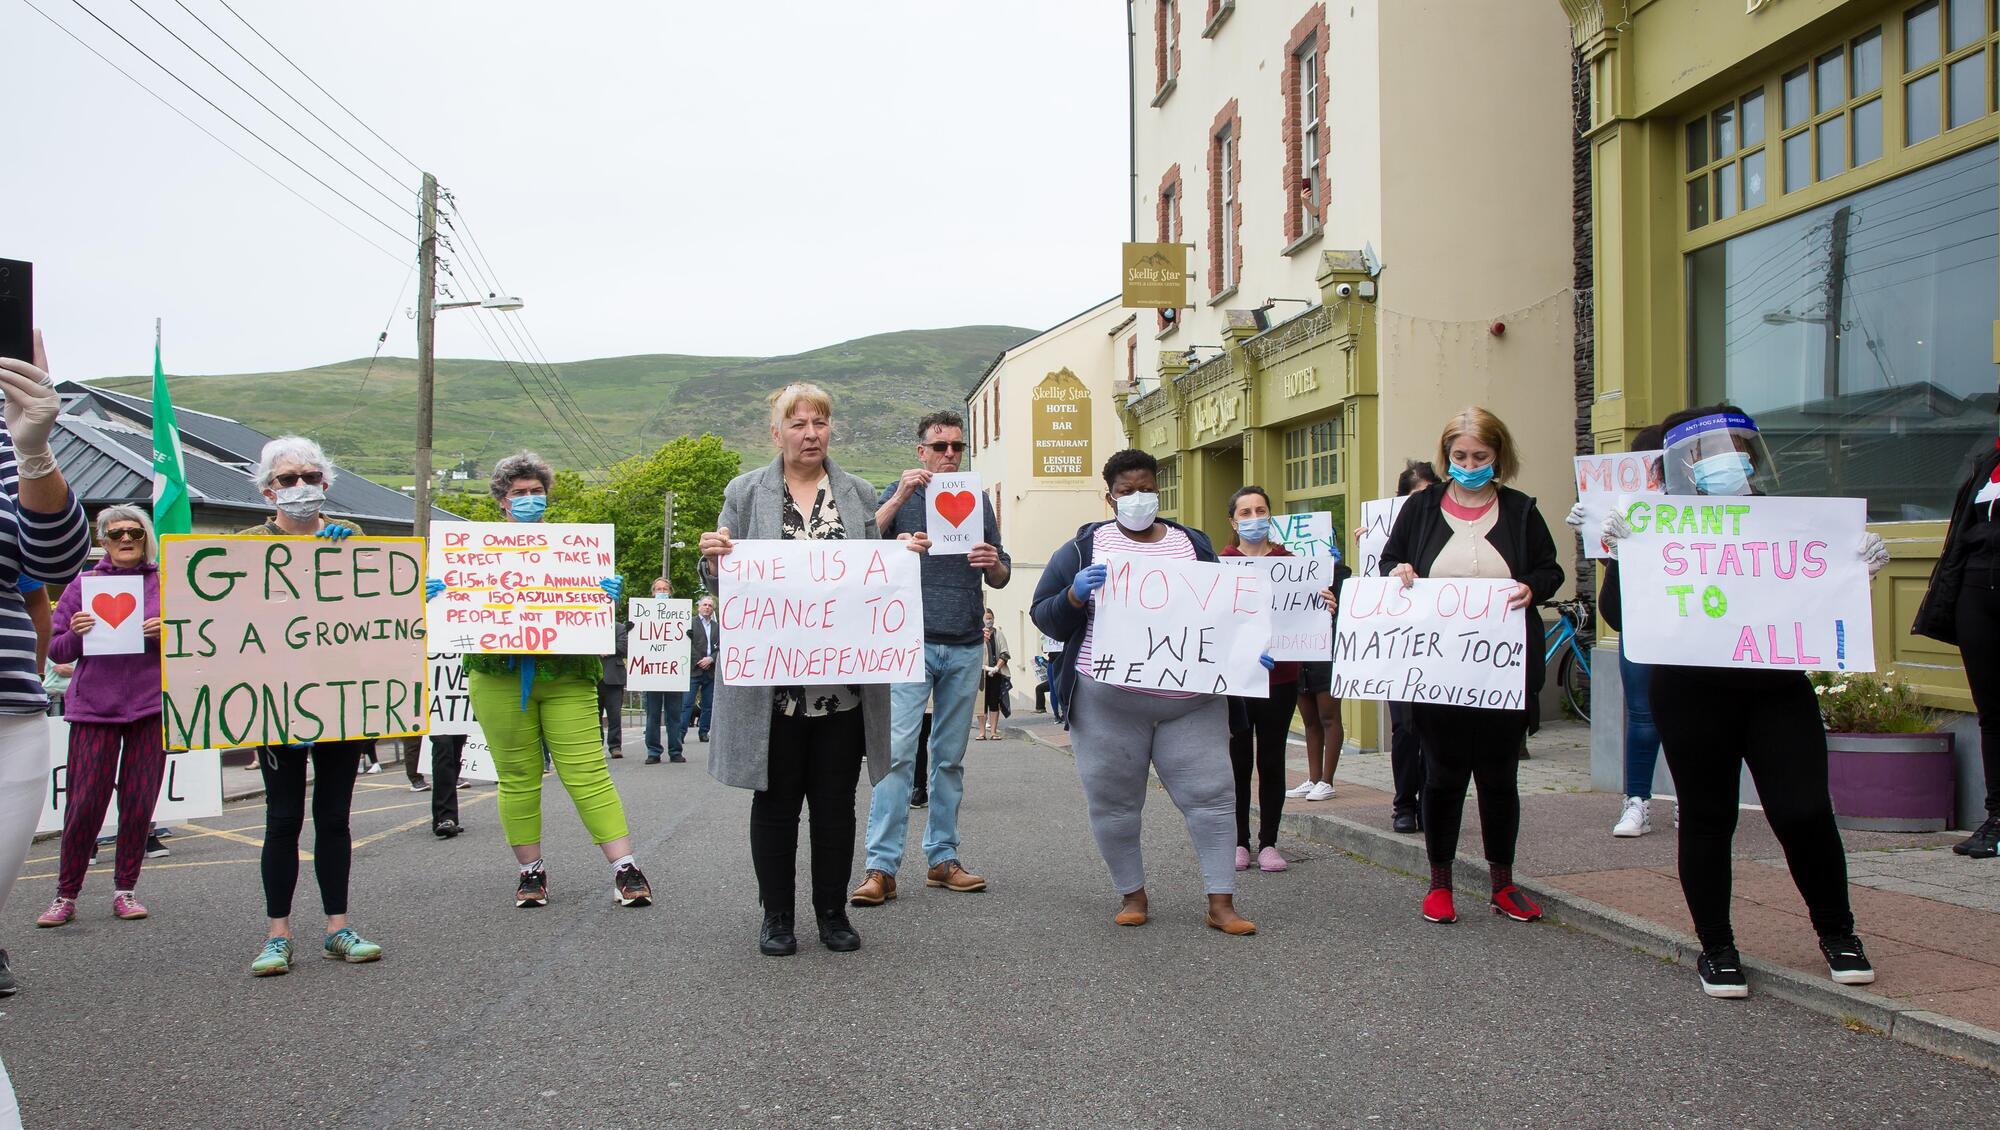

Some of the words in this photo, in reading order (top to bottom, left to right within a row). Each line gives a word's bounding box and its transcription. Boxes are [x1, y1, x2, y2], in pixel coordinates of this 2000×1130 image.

[1128, 267, 1159, 282] Skellig
[1161, 268, 1181, 281] Star
[1032, 386, 1066, 401] Skellig
[1068, 386, 1091, 400] Star
[1284, 366, 1317, 399] HOTEL
[1046, 404, 1078, 413] HOTEL
[1052, 421, 1072, 430] BAR
[1036, 439, 1089, 448] RESTAURANT
[1043, 456, 1082, 465] LEISURE
[1044, 465, 1082, 473] CENTRE
[941, 481, 966, 489] LOVE
[1625, 501, 1751, 536] GRANT
[444, 532, 471, 547] DP
[483, 534, 549, 547] OWNERS
[562, 534, 599, 549] CAN
[942, 534, 962, 543] NOT
[963, 534, 970, 542] €
[445, 552, 503, 566] EXPECT
[517, 551, 541, 564] TO
[553, 551, 591, 564] TAKE
[597, 552, 611, 566] IN
[719, 542, 786, 581] GIVE
[808, 550, 846, 583] US
[863, 549, 889, 586] A
[1662, 540, 1828, 580] STATUS
[186, 543, 420, 602] GREED
[486, 573, 498, 586] to
[544, 573, 607, 588] ANNUALL
[1270, 561, 1320, 583] OUR
[1101, 558, 1259, 614] MOVE
[446, 591, 471, 602] FOR
[488, 591, 514, 604] 150
[517, 591, 564, 604] ASYLUM
[564, 591, 614, 605] SEEKERS
[1283, 592, 1301, 611] IF
[1350, 579, 1412, 619] US
[1437, 582, 1521, 623] OUT
[1665, 584, 1728, 618] TO
[447, 609, 513, 625] PEOPLE
[520, 612, 544, 624] NOT
[555, 606, 614, 630] PROFIT!
[721, 595, 837, 631] CHANCE
[865, 597, 906, 635] TO
[163, 618, 217, 659] IS
[239, 622, 266, 654] A
[285, 616, 427, 649] GROWING
[450, 627, 558, 650] #endDP
[640, 620, 684, 641] LIVES
[1269, 633, 1328, 650] LIDARITY
[650, 644, 667, 652] NOT
[1147, 626, 1215, 663] WE
[1333, 626, 1443, 663] MATTER
[724, 647, 756, 681] BE
[1332, 674, 1395, 700] DIRECT
[1401, 667, 1523, 710] PROVISION
[162, 679, 423, 750] MONSTER!
